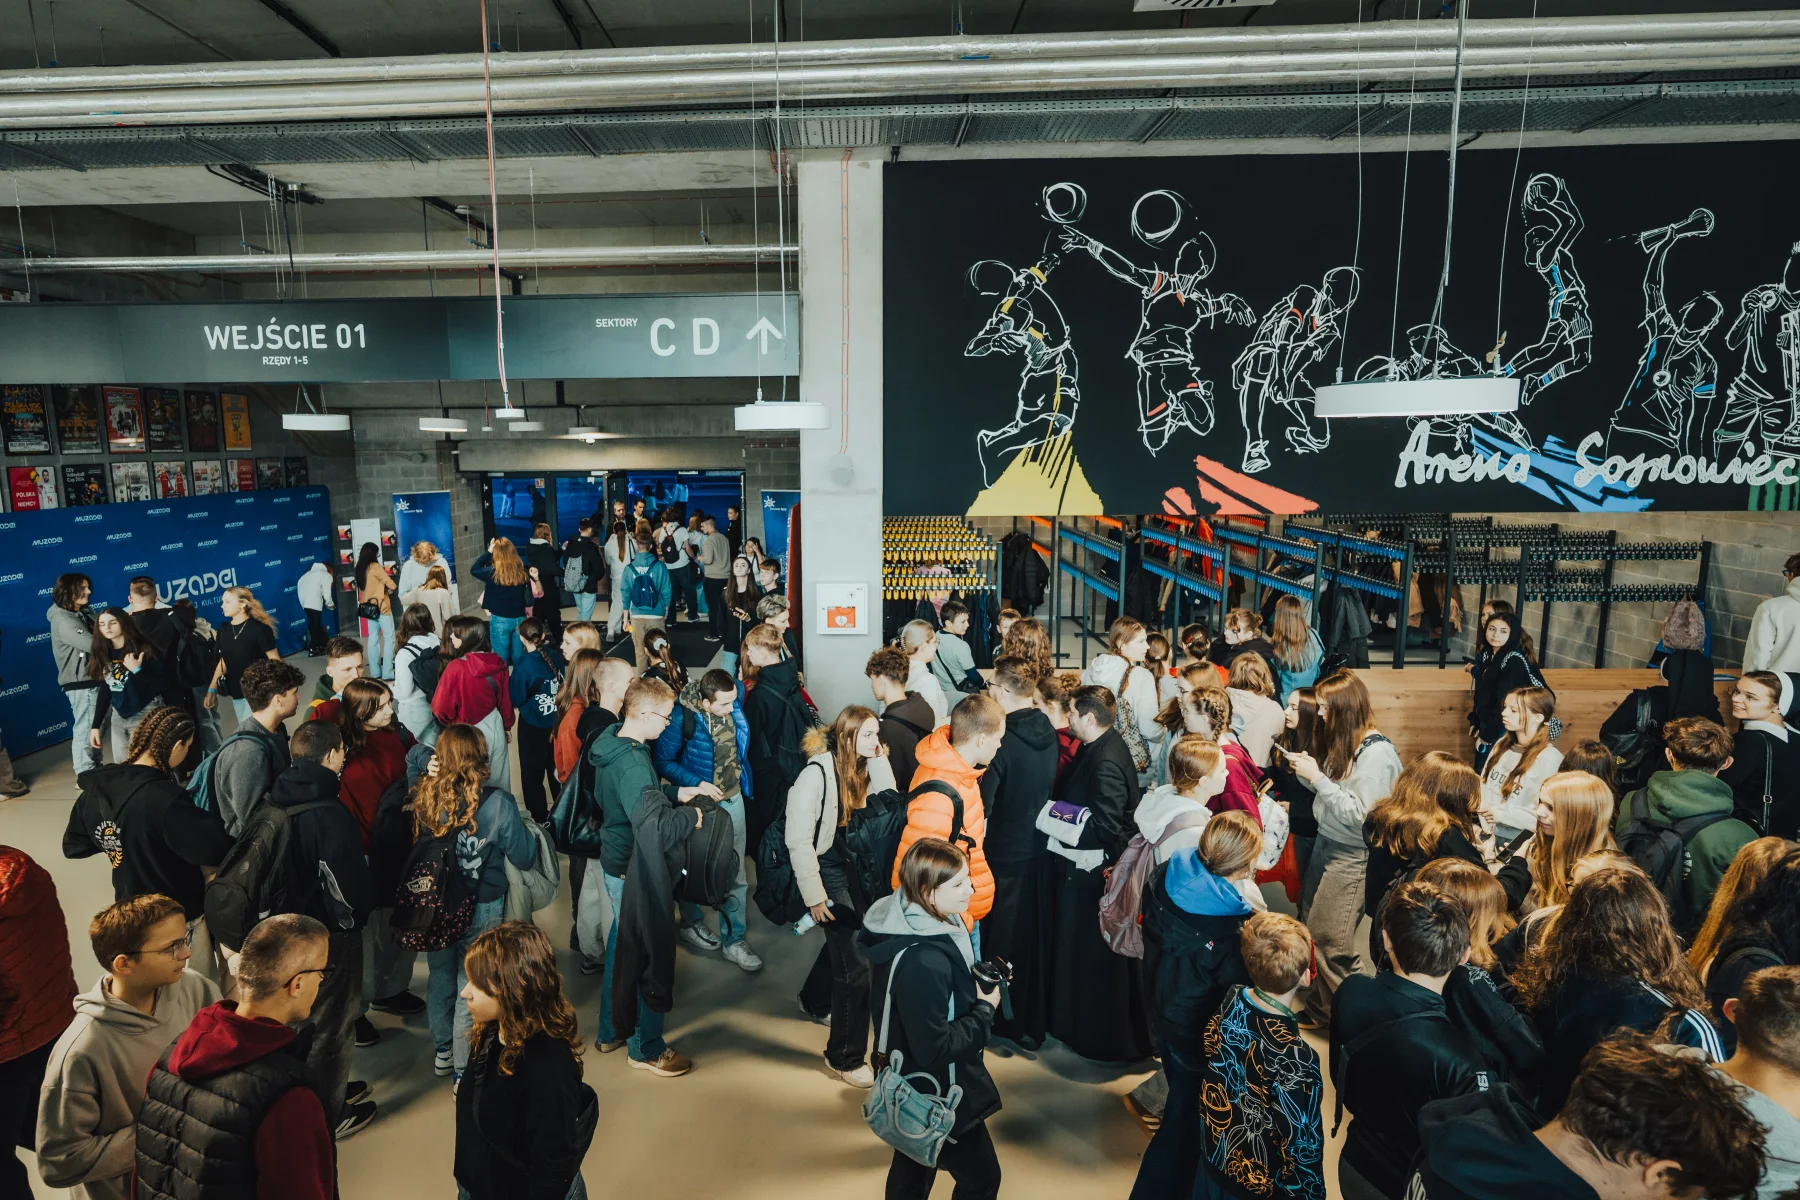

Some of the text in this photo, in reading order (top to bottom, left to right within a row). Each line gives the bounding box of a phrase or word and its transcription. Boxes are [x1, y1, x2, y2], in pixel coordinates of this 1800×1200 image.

[203, 317, 366, 350] WEJŚCIE 01
[595, 318, 638, 328] SEKTORY
[650, 317, 720, 357] C D
[262, 355, 309, 367] RZĘDY 1-5
[1394, 419, 1800, 487] Arena Sosnowiec
[201, 595, 222, 607] KULTU
